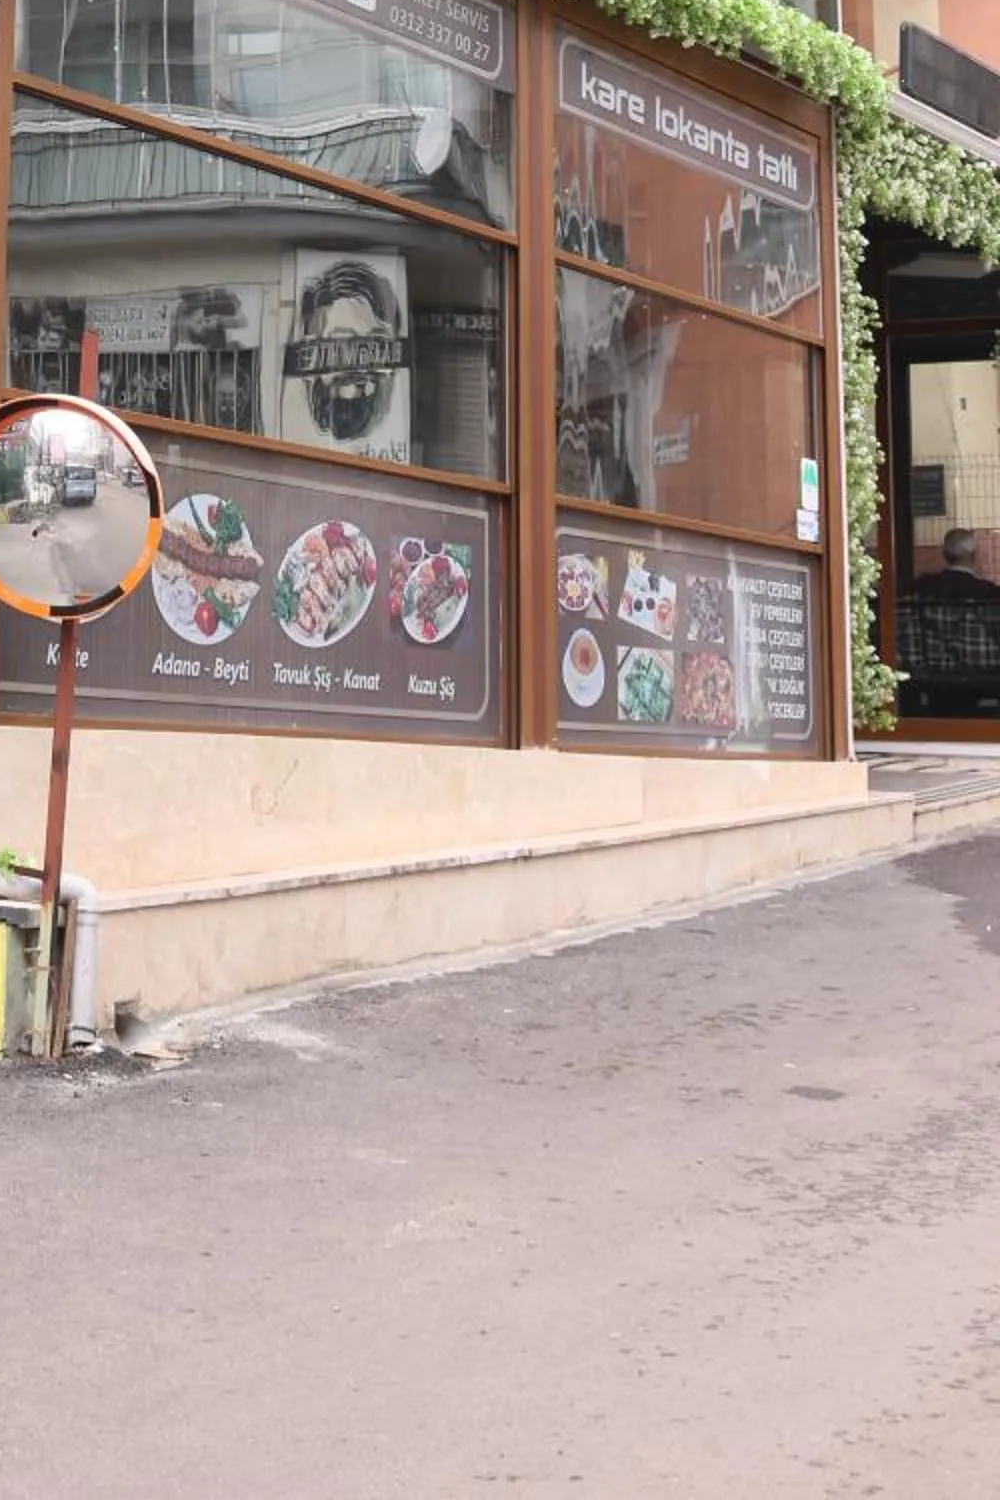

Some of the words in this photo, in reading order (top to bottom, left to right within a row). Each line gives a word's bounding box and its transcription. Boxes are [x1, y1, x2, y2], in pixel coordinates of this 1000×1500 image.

[389, 4, 425, 35] 0312
[426, 18, 453, 45] 337
[455, 32, 472, 54] 00
[473, 40, 491, 61] 27
[580, 61, 646, 125] kare
[655, 95, 749, 170] lokanta
[46, 642, 89, 669] Kte
[152, 651, 201, 678] Adana
[213, 658, 250, 685] Beyti
[273, 662, 312, 687] Tavuk
[313, 665, 332, 693] Şiş
[343, 667, 381, 691] Kanat
[438, 677, 457, 701] Şiş
